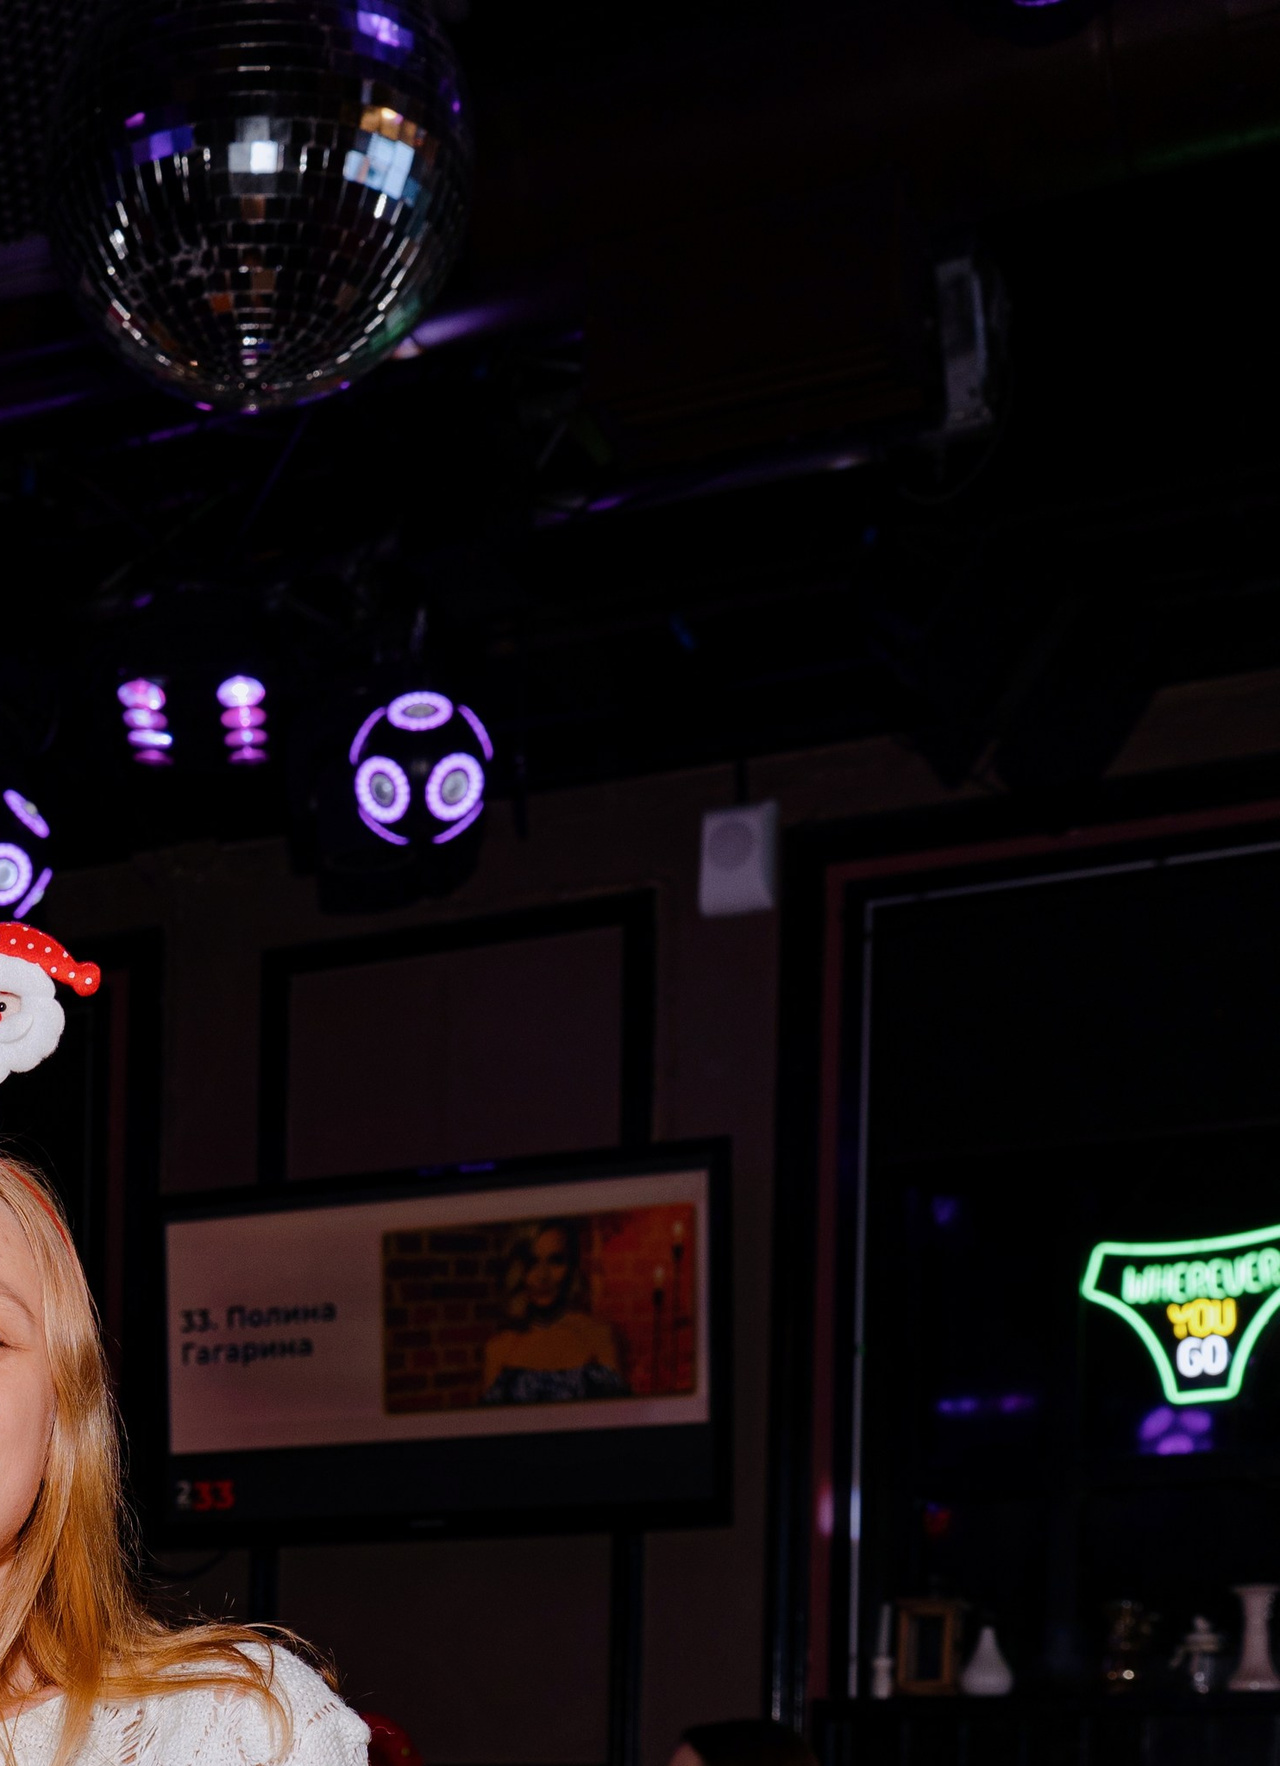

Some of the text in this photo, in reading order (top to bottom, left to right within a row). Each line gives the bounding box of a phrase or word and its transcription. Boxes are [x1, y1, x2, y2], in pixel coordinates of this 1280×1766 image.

[1122, 1247, 1280, 1304] WHEREVER
[226, 1302, 336, 1332] Полина
[1167, 1298, 1237, 1340] YOU
[182, 1338, 313, 1366] Гагарина
[1176, 1335, 1229, 1378] GO
